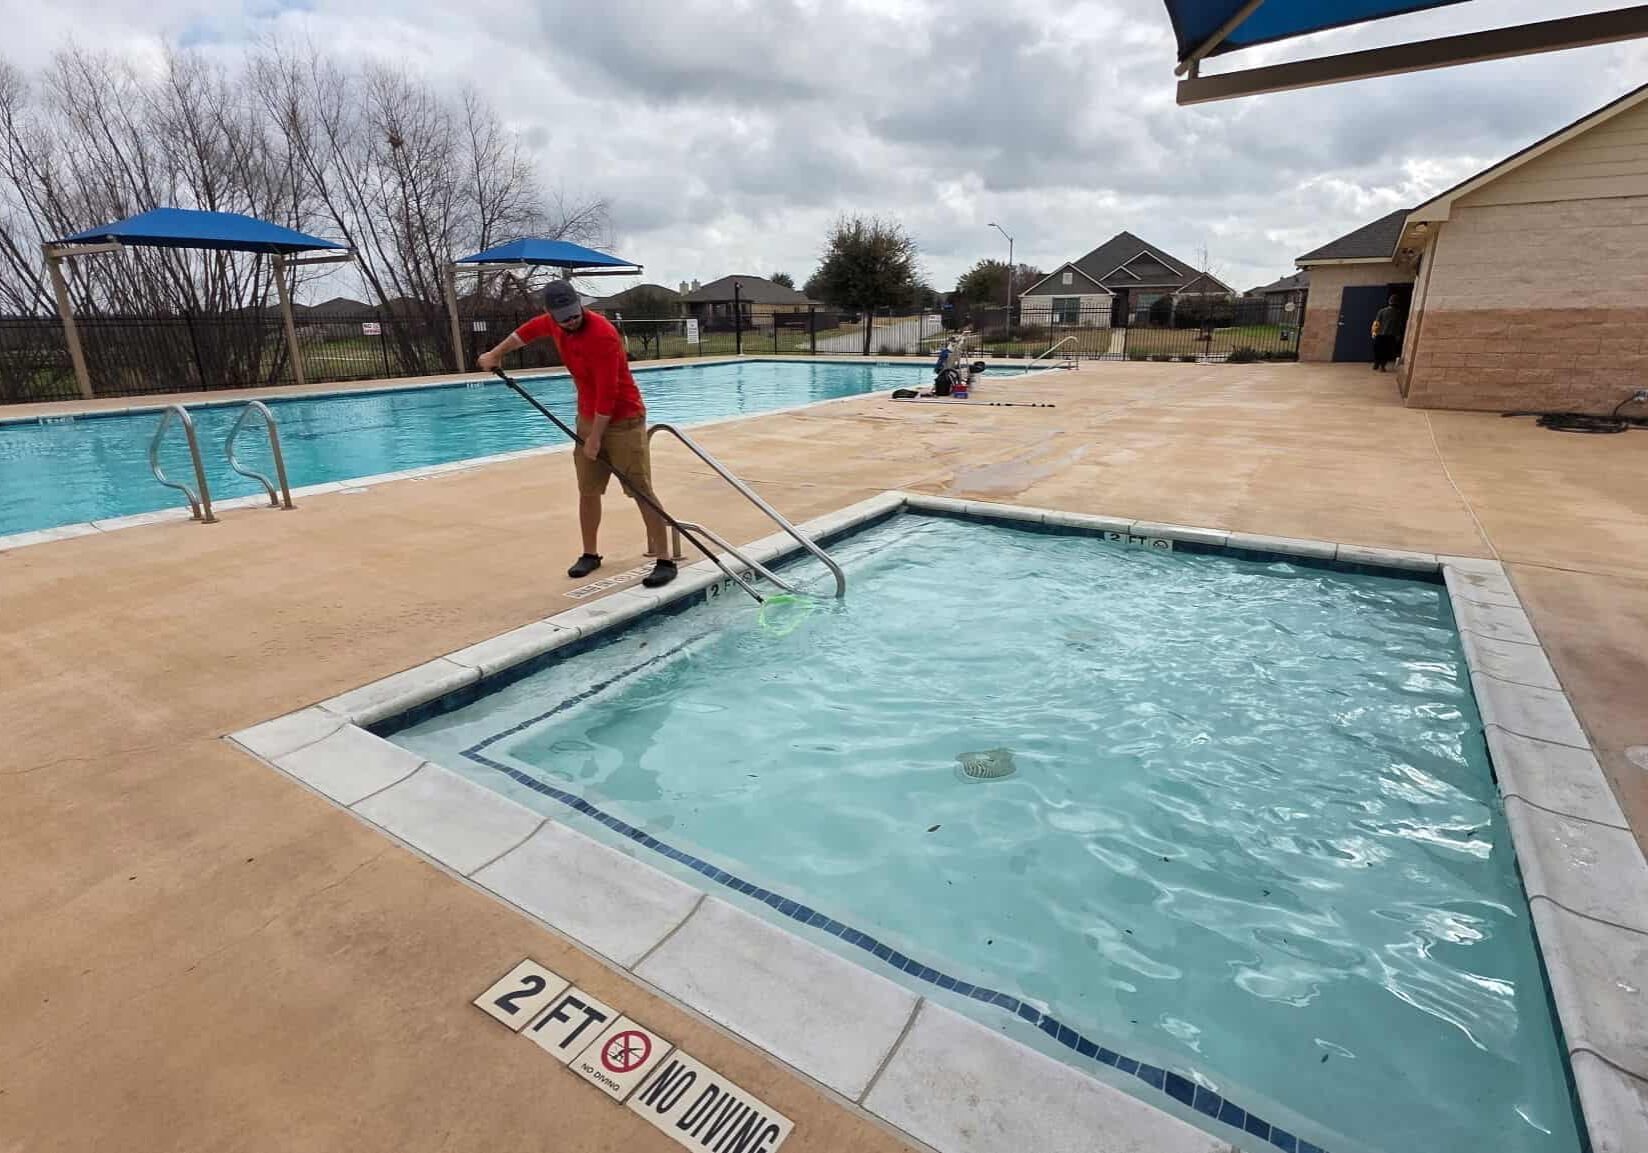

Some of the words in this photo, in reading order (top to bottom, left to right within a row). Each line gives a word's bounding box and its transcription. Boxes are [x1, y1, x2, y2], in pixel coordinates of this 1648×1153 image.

[1110, 533, 1120, 541] 2
[1129, 535, 1147, 544] FT
[711, 583, 720, 598] 2
[494, 975, 547, 1016] 2
[532, 995, 608, 1049] FT
[581, 1063, 594, 1074] NO
[594, 1071, 620, 1092] DIVING
[638, 1060, 697, 1114] NO
